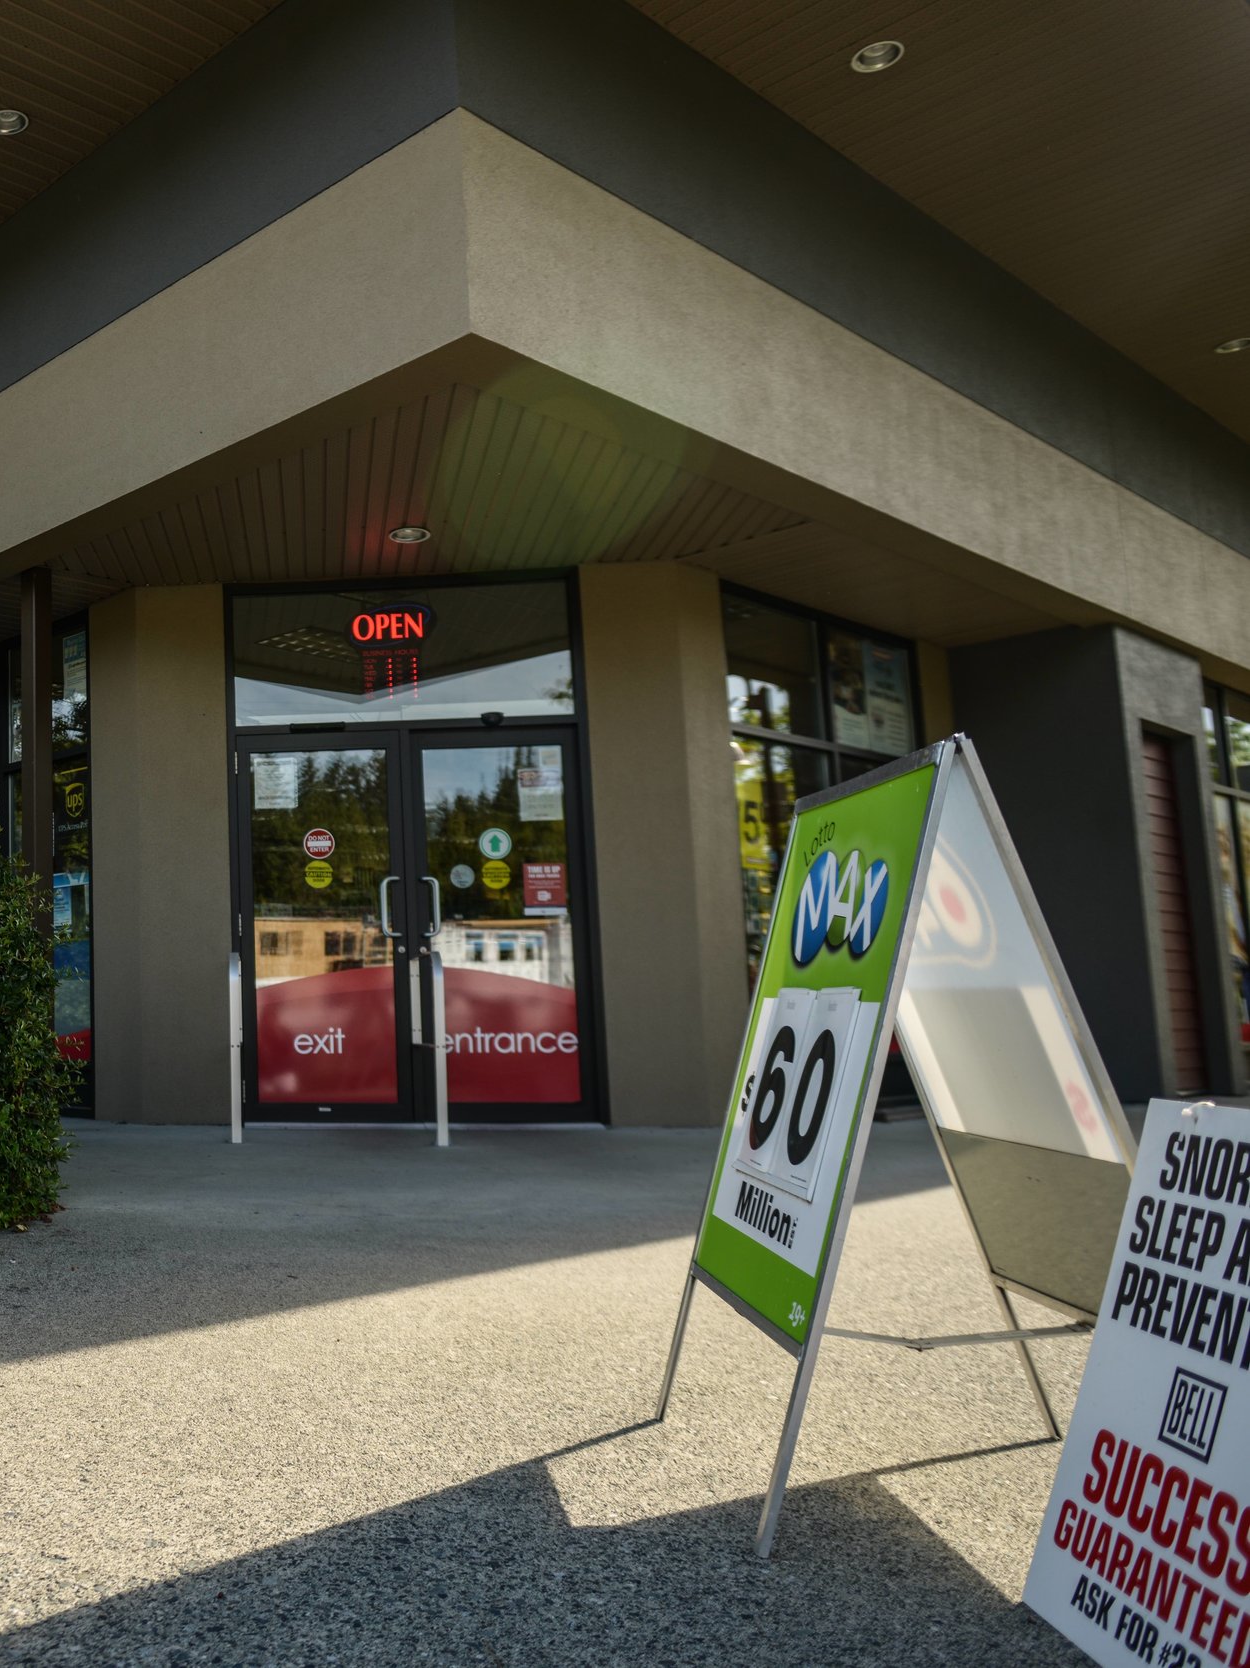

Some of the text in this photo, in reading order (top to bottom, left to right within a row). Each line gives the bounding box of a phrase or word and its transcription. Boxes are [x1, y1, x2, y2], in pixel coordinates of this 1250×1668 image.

[352, 612, 424, 641] OPEN
[67, 793, 83, 812] ups
[803, 821, 836, 867] Lotto
[794, 850, 888, 962] MAX
[293, 1027, 346, 1054] exit
[734, 1181, 792, 1246] Million
[1129, 1195, 1226, 1272] SLEEP
[788, 1301, 806, 1327] 19+
[1167, 1378, 1214, 1450] BELL
[1083, 1428, 1250, 1596] SUCCESS
[1054, 1499, 1250, 1668] GUARANTEED
[1070, 1574, 1116, 1631] ASK
[1114, 1604, 1159, 1664] FOR
